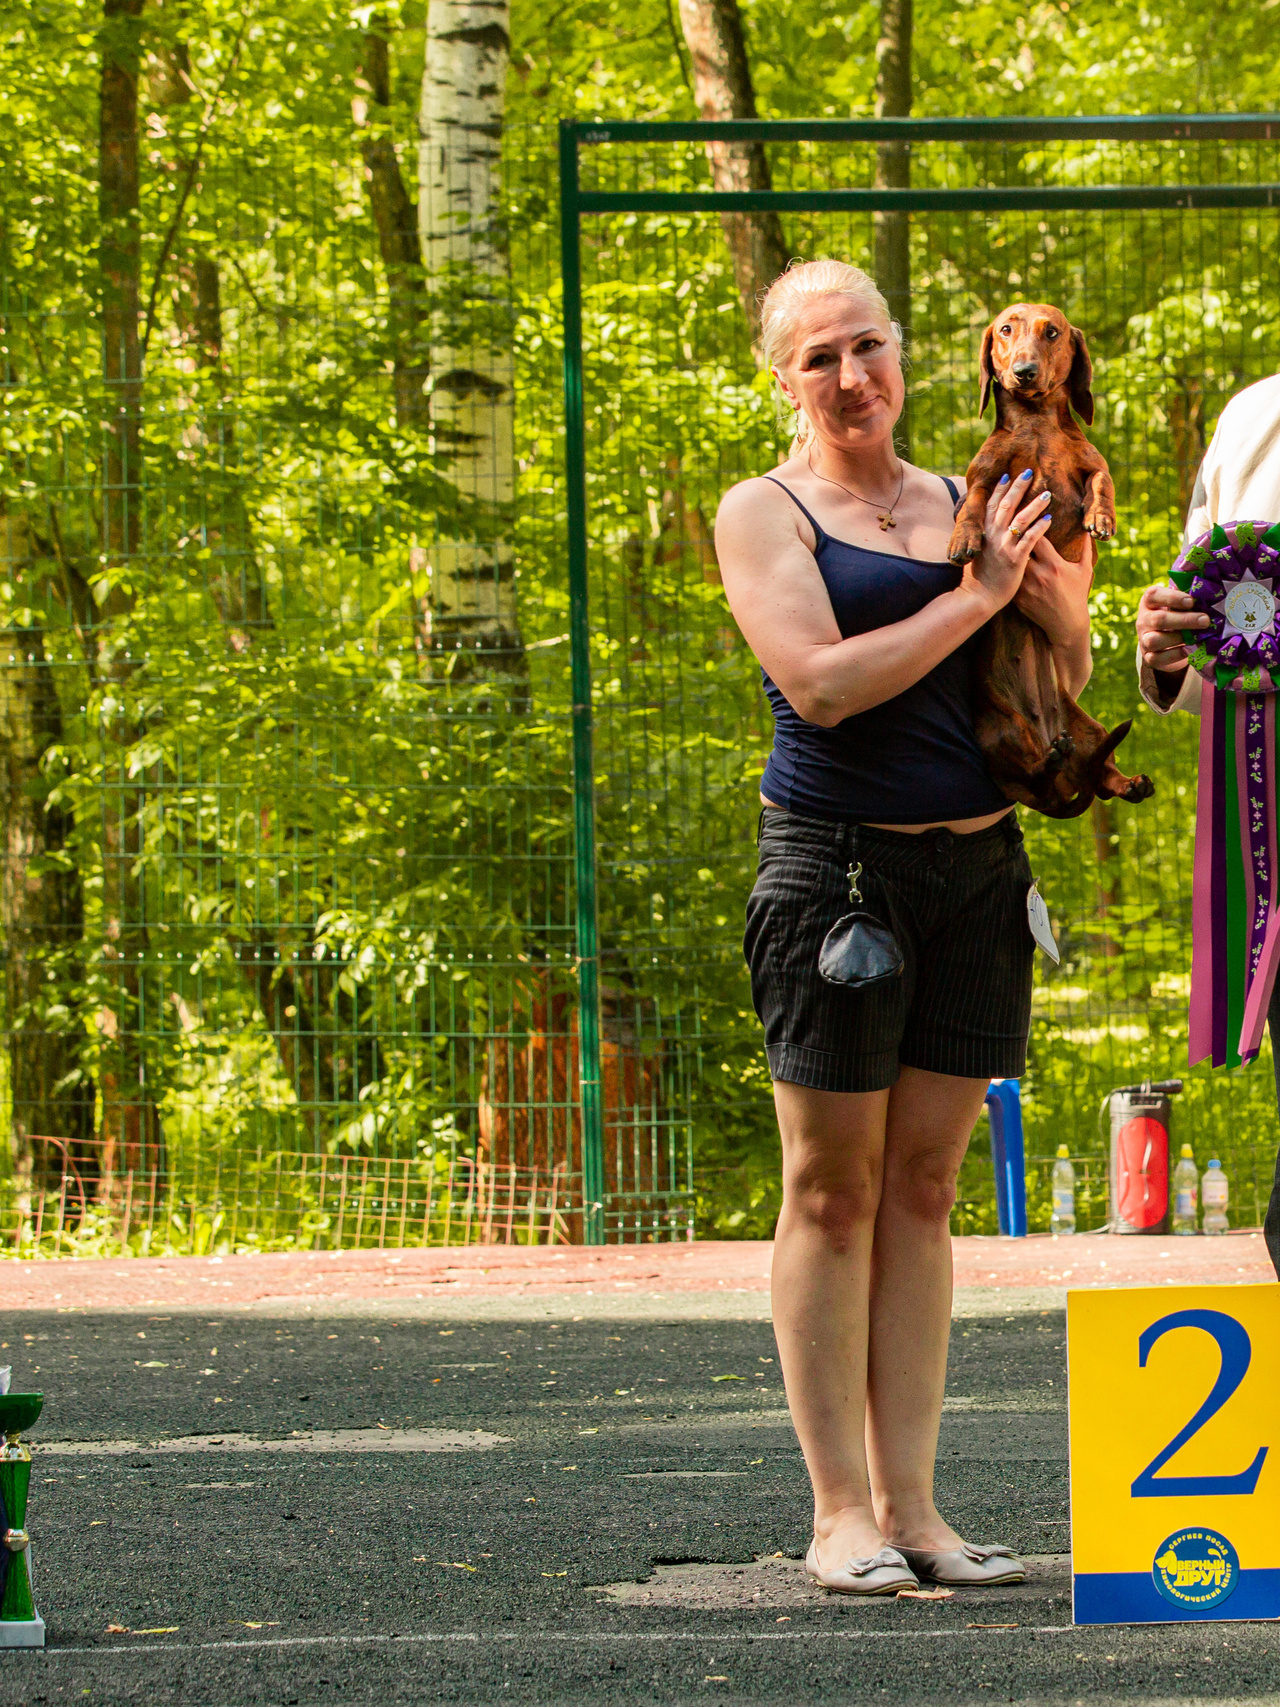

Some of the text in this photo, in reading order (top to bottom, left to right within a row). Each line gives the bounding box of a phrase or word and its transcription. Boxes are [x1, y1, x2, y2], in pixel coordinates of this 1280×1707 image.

[1130, 1308, 1270, 1498] 2
[1168, 1533, 1229, 1556] СЕРГИЕВ ПОСАД
[1177, 1559, 1226, 1570] ВЕРНЫЙ
[1173, 1570, 1226, 1586] ДРУГ
